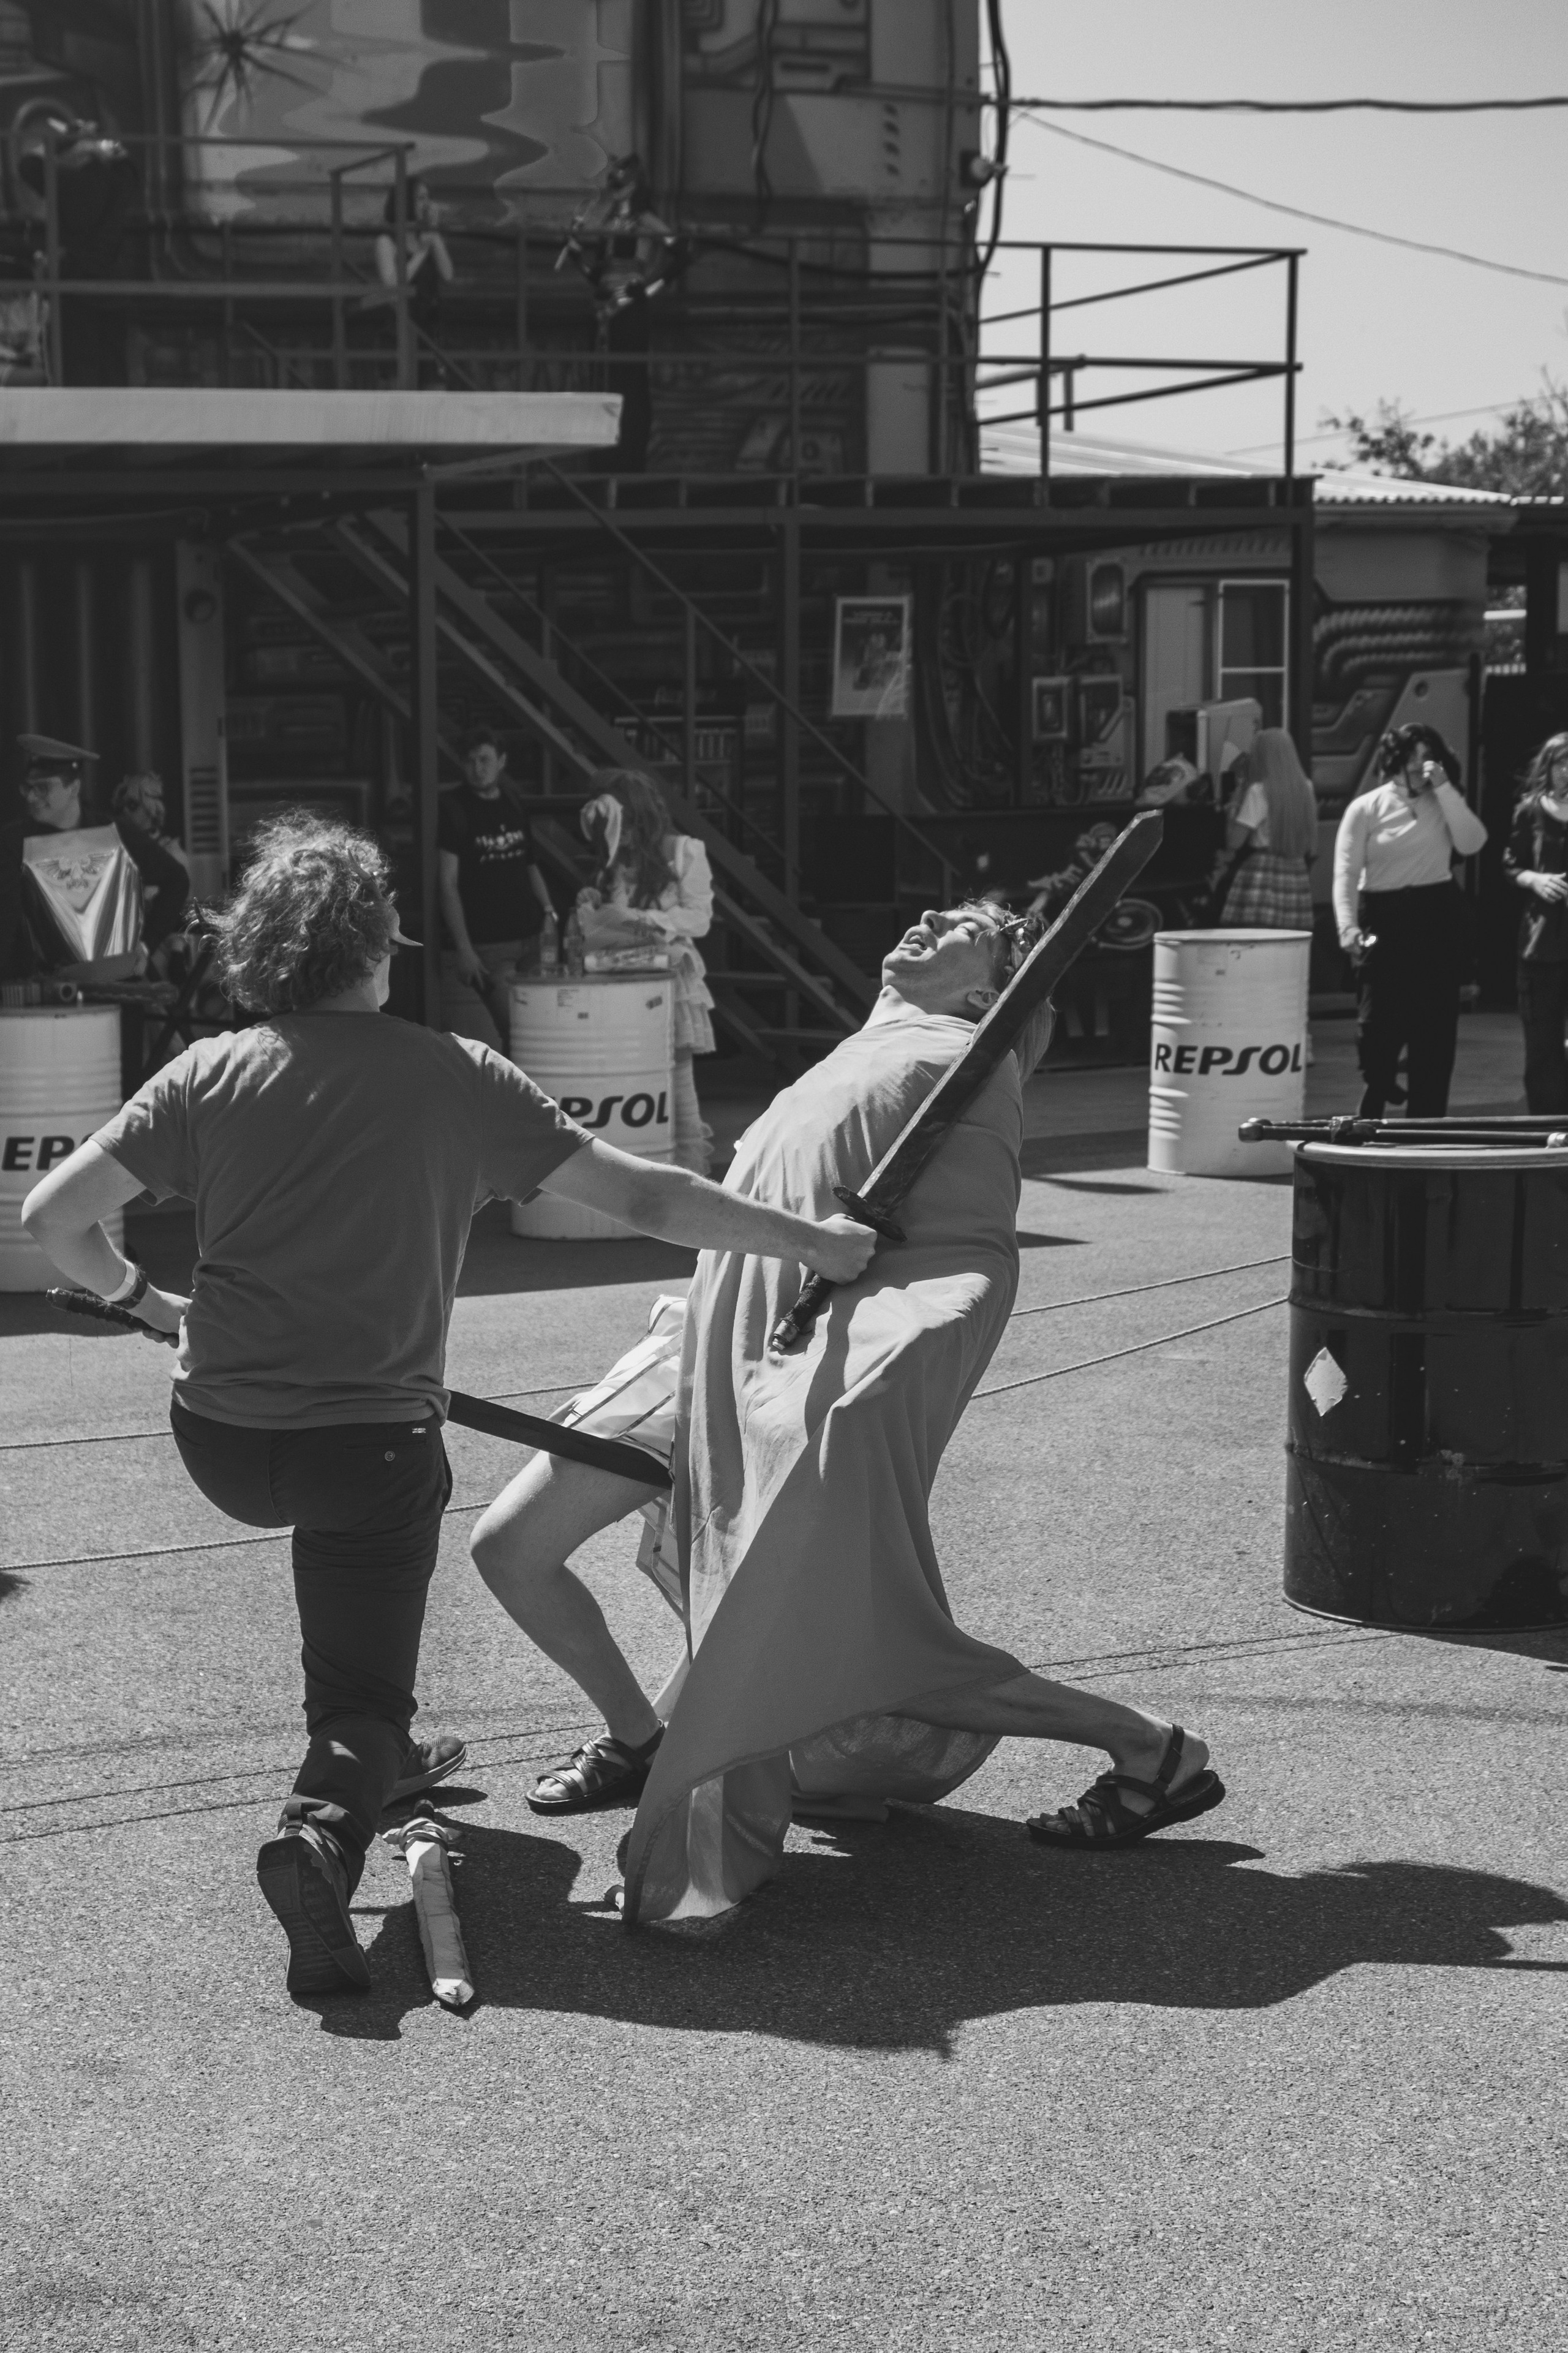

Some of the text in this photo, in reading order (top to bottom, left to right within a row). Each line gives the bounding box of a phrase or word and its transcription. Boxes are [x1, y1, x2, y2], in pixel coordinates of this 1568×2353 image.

[1155, 1043, 1302, 1076] REPSOL
[550, 1092, 669, 1128] PSOL
[0, 1132, 96, 1171] EP
